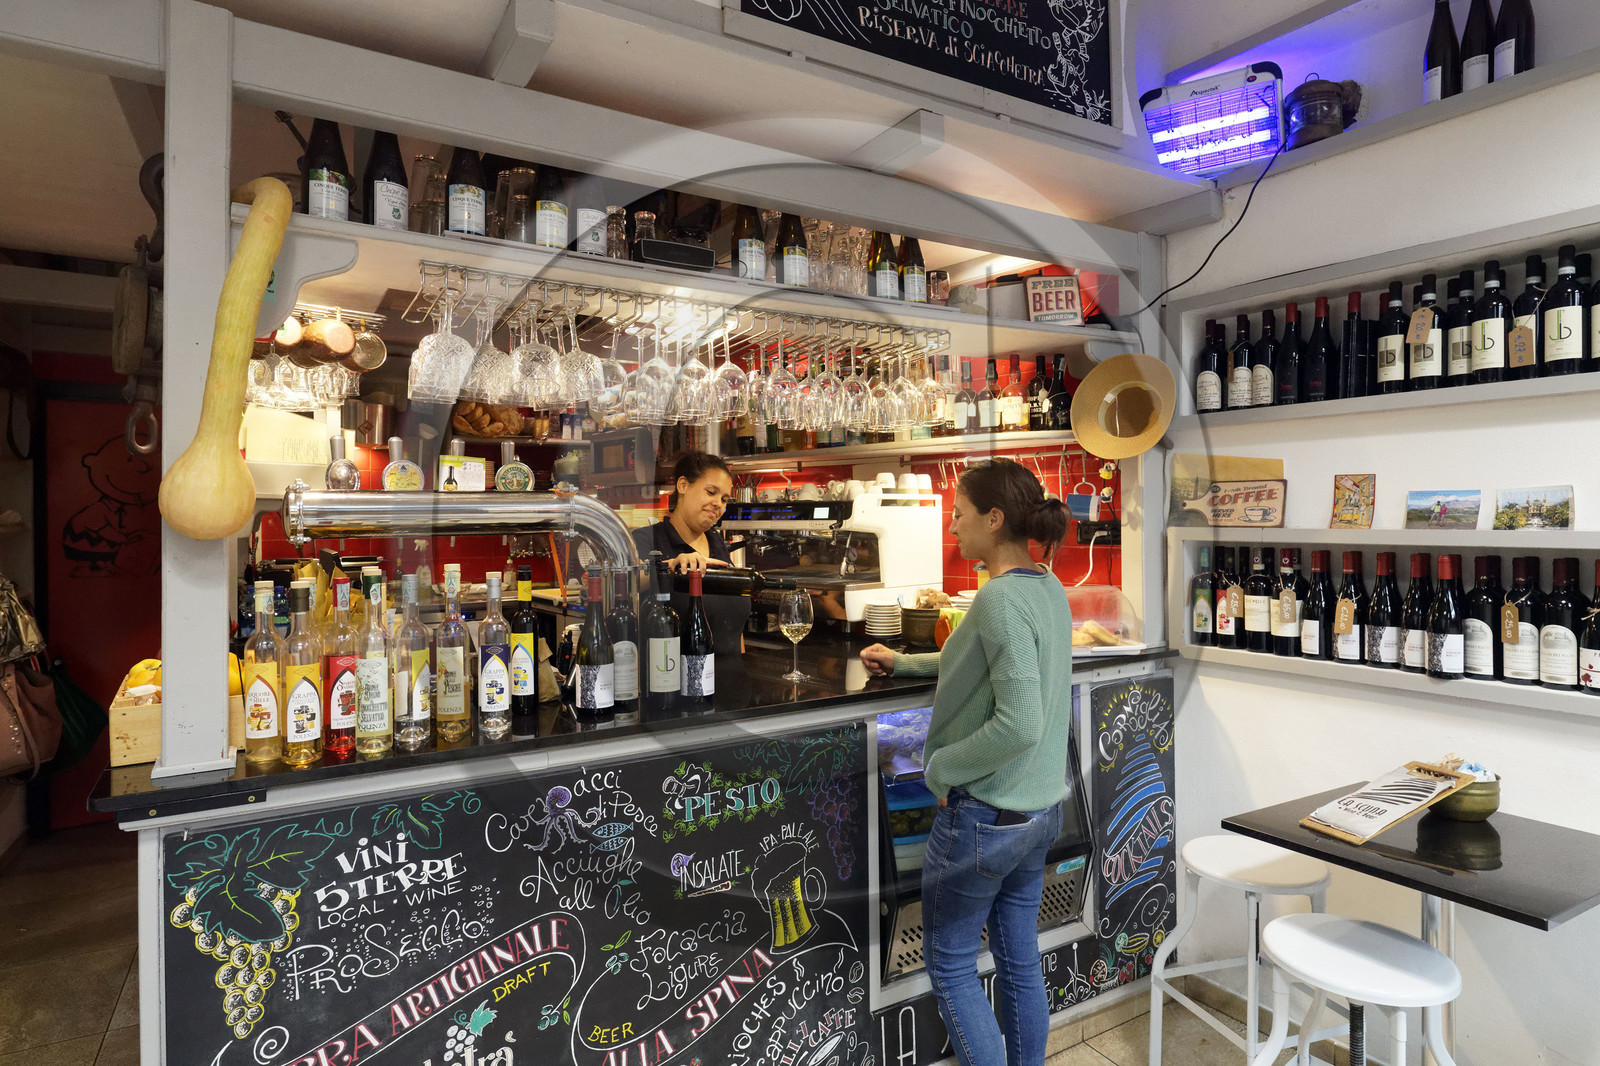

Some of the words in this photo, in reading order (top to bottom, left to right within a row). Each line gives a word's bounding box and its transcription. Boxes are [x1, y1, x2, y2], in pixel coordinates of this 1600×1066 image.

[858, 6, 940, 51] RiSERVA
[945, 36, 959, 58] di
[1031, 278, 1074, 290] FREE
[1032, 290, 1077, 312] BEER
[1037, 313, 1075, 321] TOMORROW
[1208, 488, 1279, 507] COFFEE
[608, 790, 658, 837] Pesce
[682, 778, 781, 822] PESTO
[759, 833, 778, 852] IPA
[781, 822, 805, 840] PALE
[1104, 799, 1174, 884] COCKTAILS
[314, 880, 348, 912] 5
[347, 852, 467, 899] TERRE
[519, 837, 643, 903] Acciughe
[680, 849, 748, 893] INSALATE
[317, 901, 385, 930] LOCAL
[604, 882, 651, 925] Olio
[390, 918, 570, 1037] ARTIGIANALE
[492, 961, 551, 1003] DRAFT
[684, 946, 776, 1041] SPINA
[588, 1022, 634, 1044] BEER
